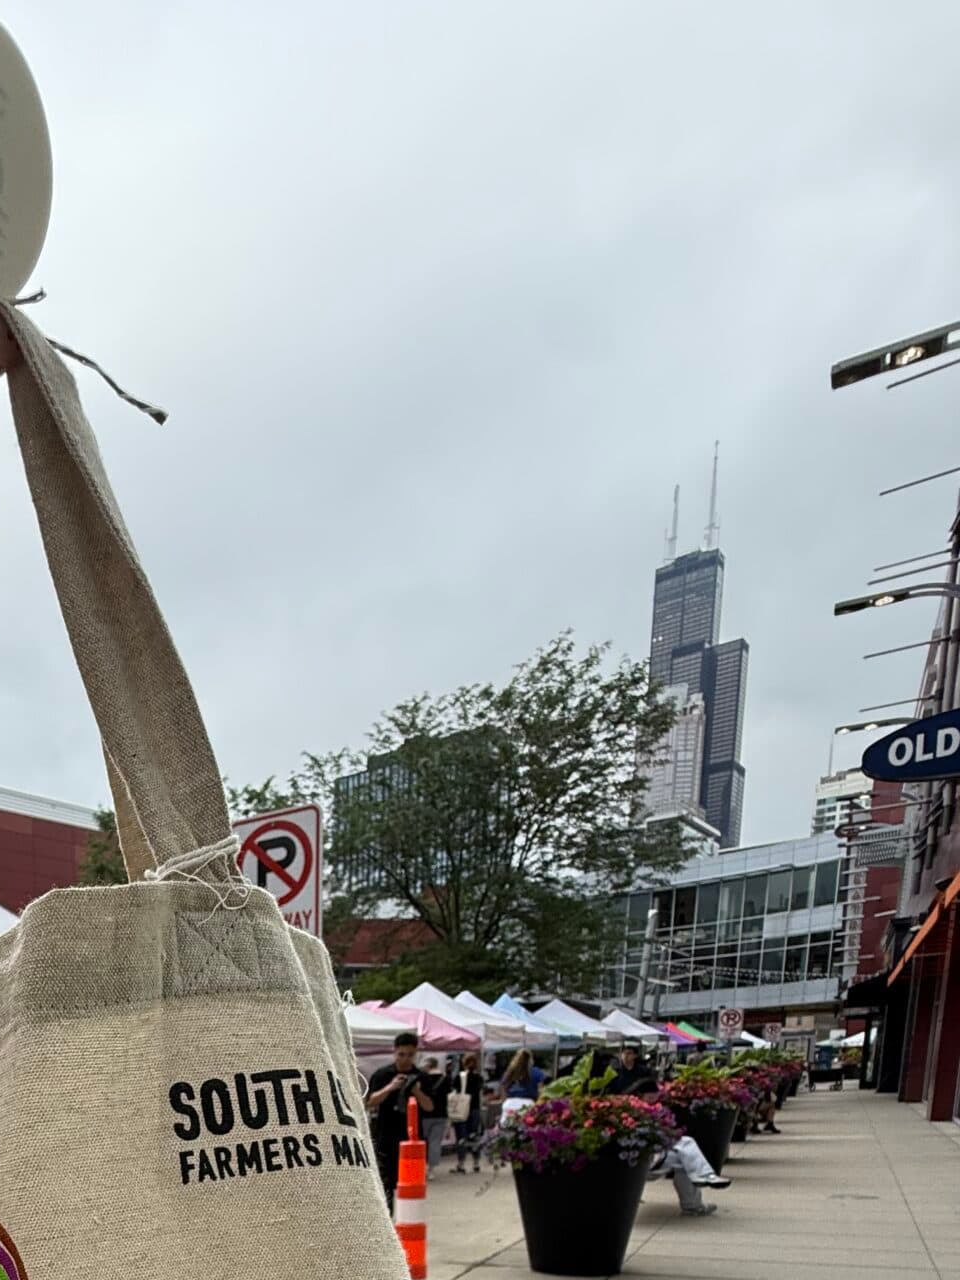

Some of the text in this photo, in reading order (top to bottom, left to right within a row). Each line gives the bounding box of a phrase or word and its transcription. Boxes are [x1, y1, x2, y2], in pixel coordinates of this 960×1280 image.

[887, 727, 960, 767] OLD
[169, 1069, 325, 1141] SOUTH
[179, 1134, 322, 1185] FARMERS
